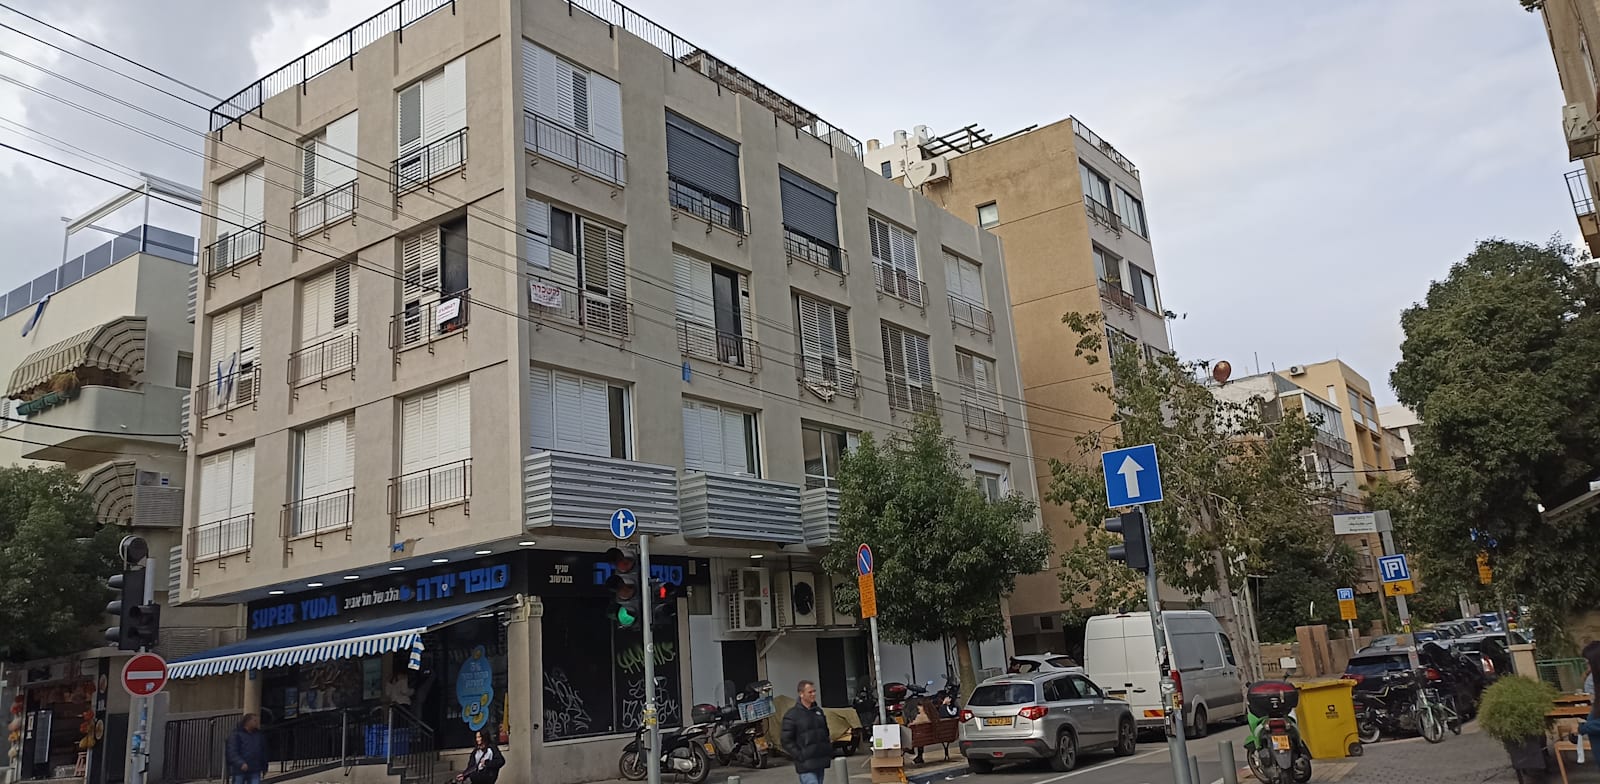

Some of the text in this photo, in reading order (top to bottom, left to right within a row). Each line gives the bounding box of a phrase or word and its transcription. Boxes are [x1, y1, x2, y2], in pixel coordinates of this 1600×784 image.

[416, 565, 507, 601] סופר יודה
[555, 564, 569, 575] סניף
[344, 587, 400, 609] הלב של תל אביב
[252, 596, 337, 629] SUPER YUDA
